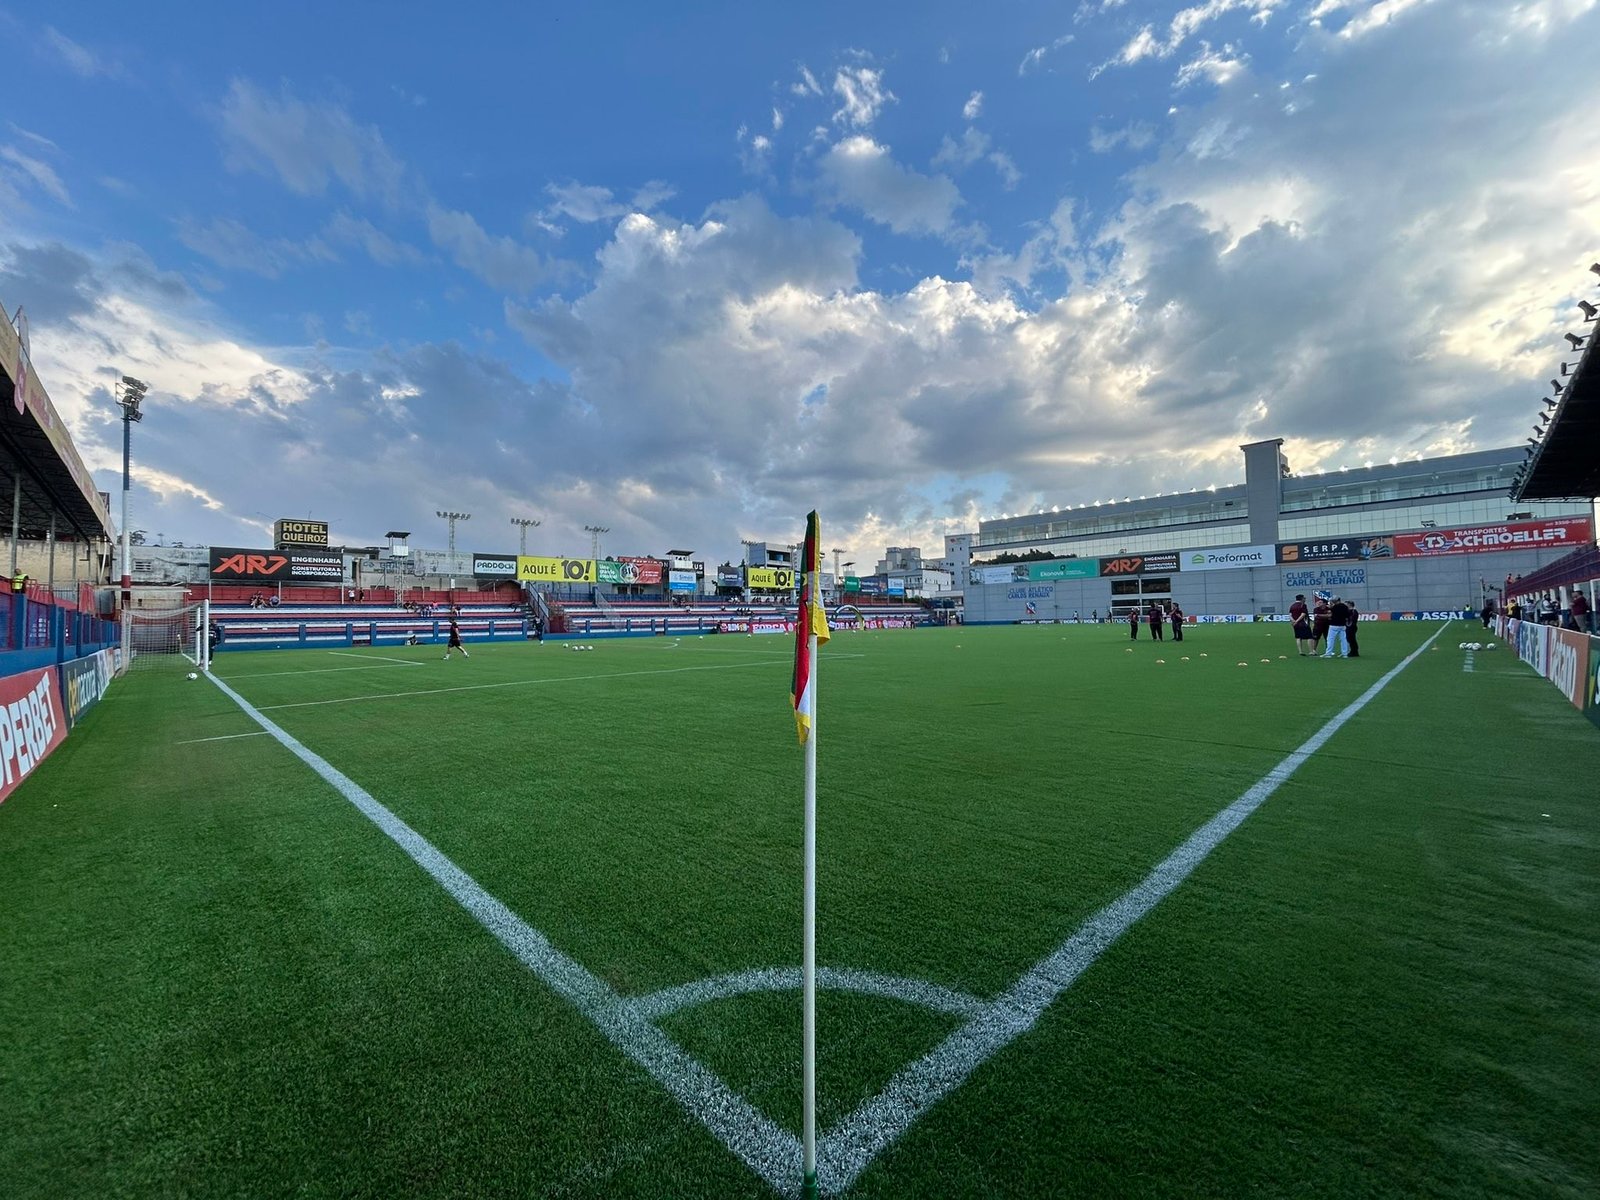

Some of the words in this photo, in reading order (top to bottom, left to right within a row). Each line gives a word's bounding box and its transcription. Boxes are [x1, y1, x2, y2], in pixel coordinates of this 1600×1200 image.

[283, 522, 327, 534] HOTEL
[1454, 526, 1507, 537] TRANSPORTES
[282, 533, 327, 543] QUEIROZ
[1454, 527, 1566, 548] SCHMOELLER
[1303, 543, 1349, 553] SERPA
[291, 556, 342, 564] ENGENHARIA
[1208, 552, 1262, 564] Preformat
[477, 561, 514, 569] PADDOCK
[523, 565, 549, 575] AQUI
[551, 563, 556, 574] É
[561, 560, 592, 581] 10!
[751, 574, 767, 583] AQUI
[774, 571, 791, 587] 10!
[1286, 571, 1315, 580] CLUBE
[1286, 578, 1321, 587] CARLOS
[1326, 576, 1366, 585] RENAUX
[0, 672, 56, 790] PERBET
